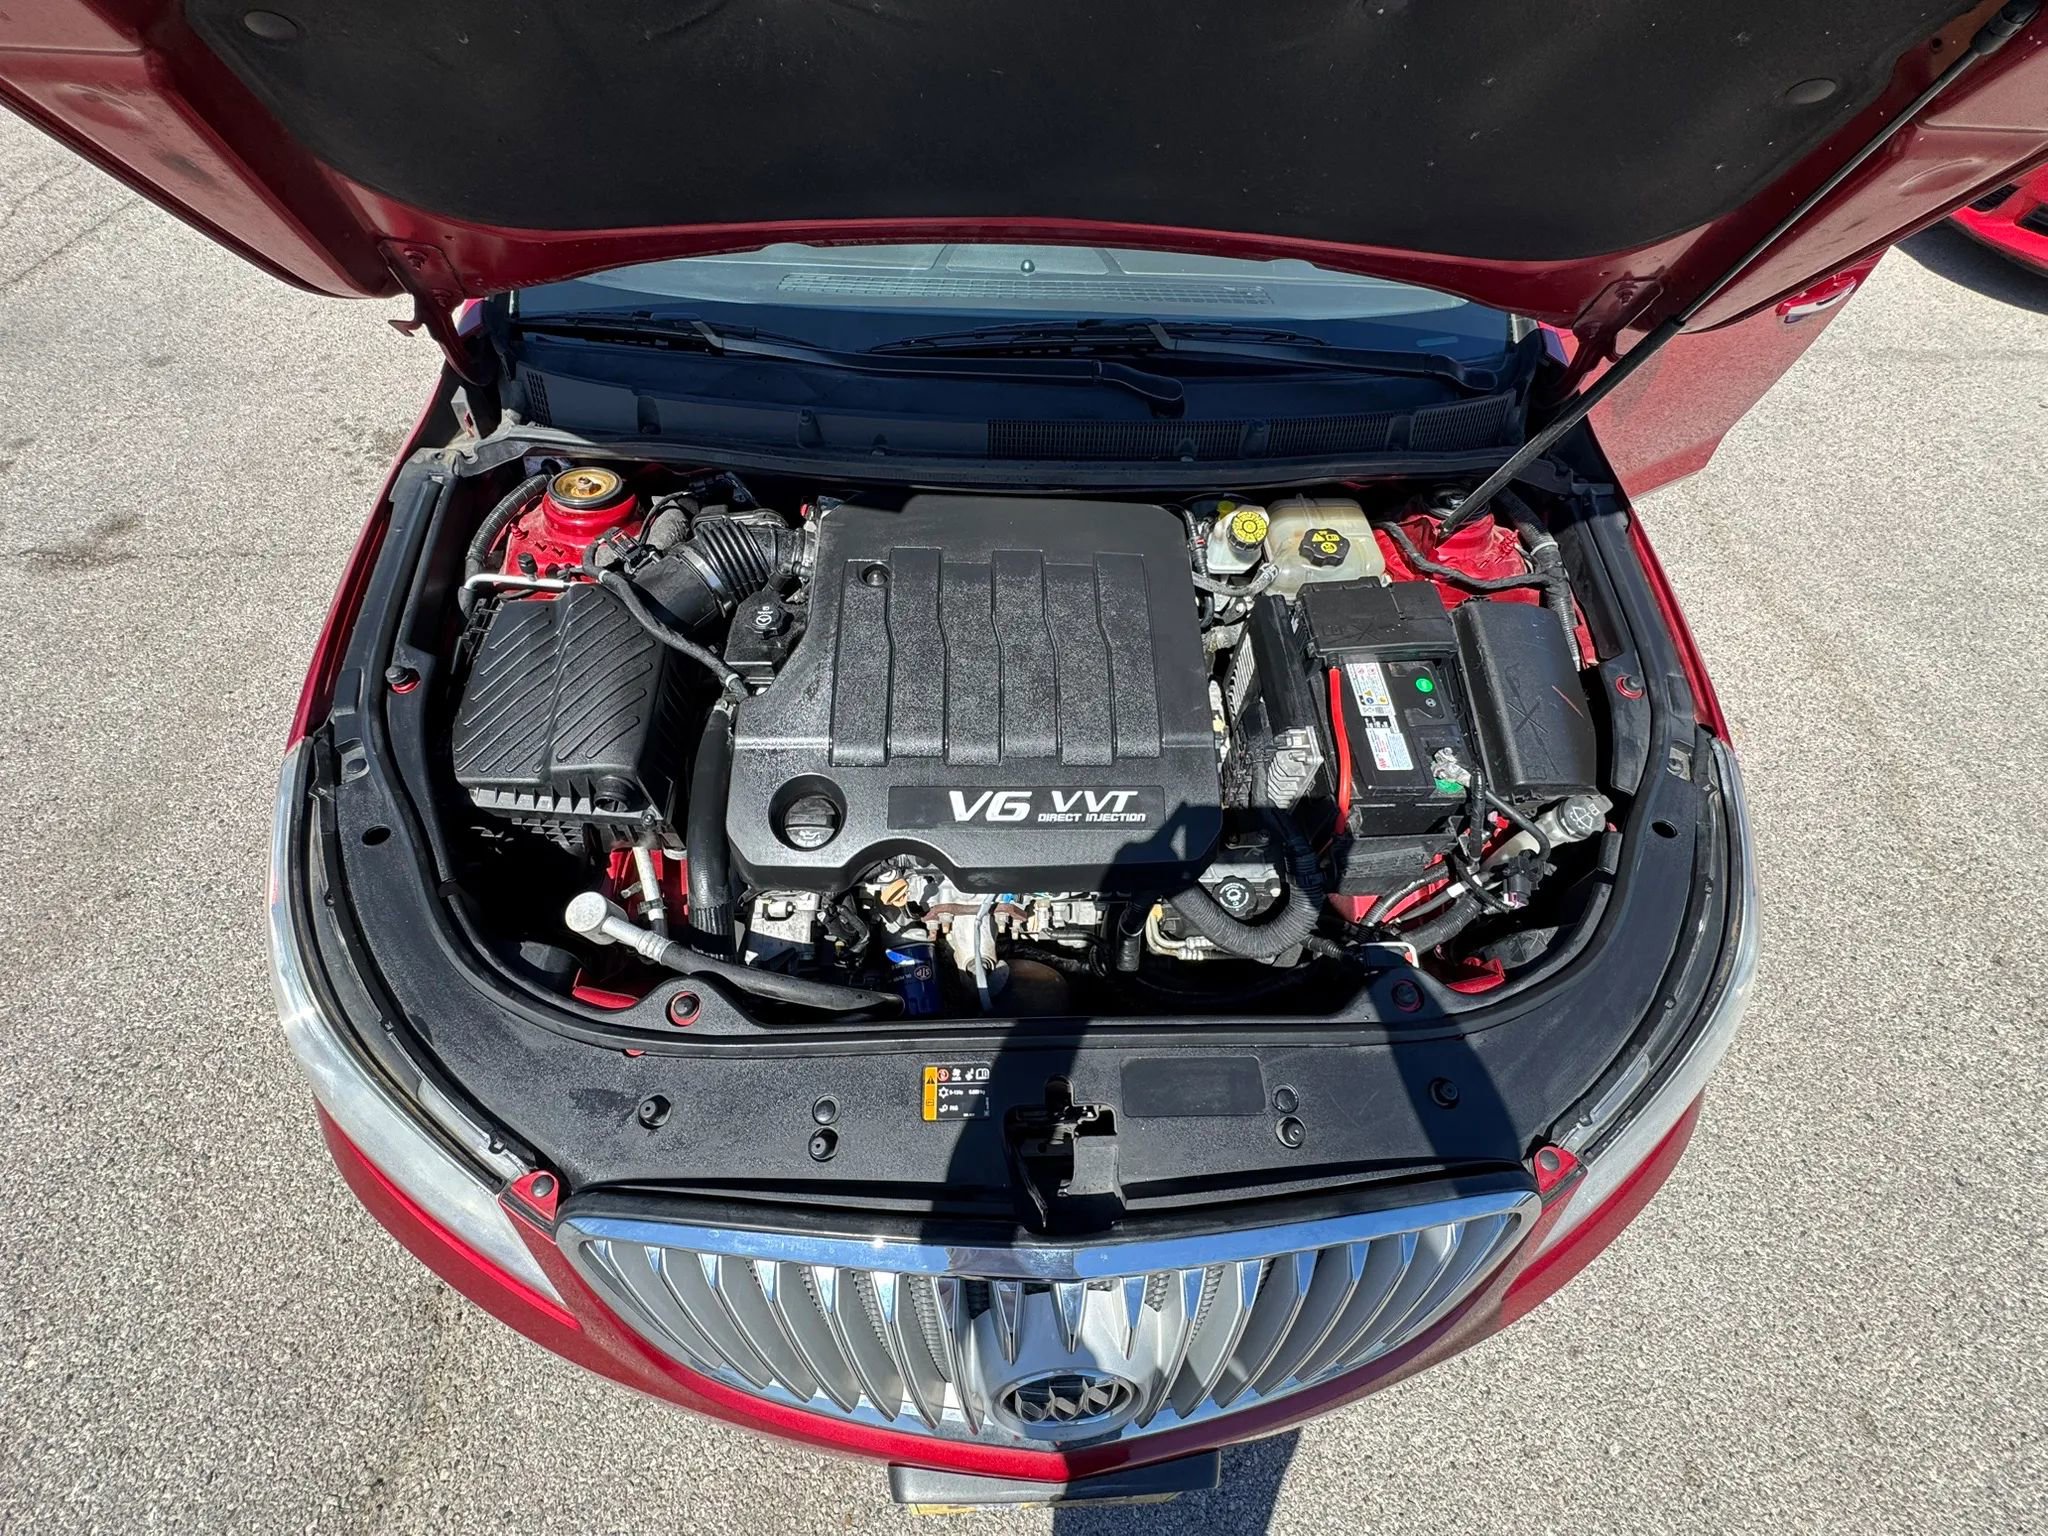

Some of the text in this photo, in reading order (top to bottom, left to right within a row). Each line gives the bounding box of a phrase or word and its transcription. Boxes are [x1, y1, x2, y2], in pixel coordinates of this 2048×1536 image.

[949, 790, 1033, 822] V6
[1051, 790, 1139, 813] VVT
[1037, 813, 1146, 823] DIRECT INJECTION
